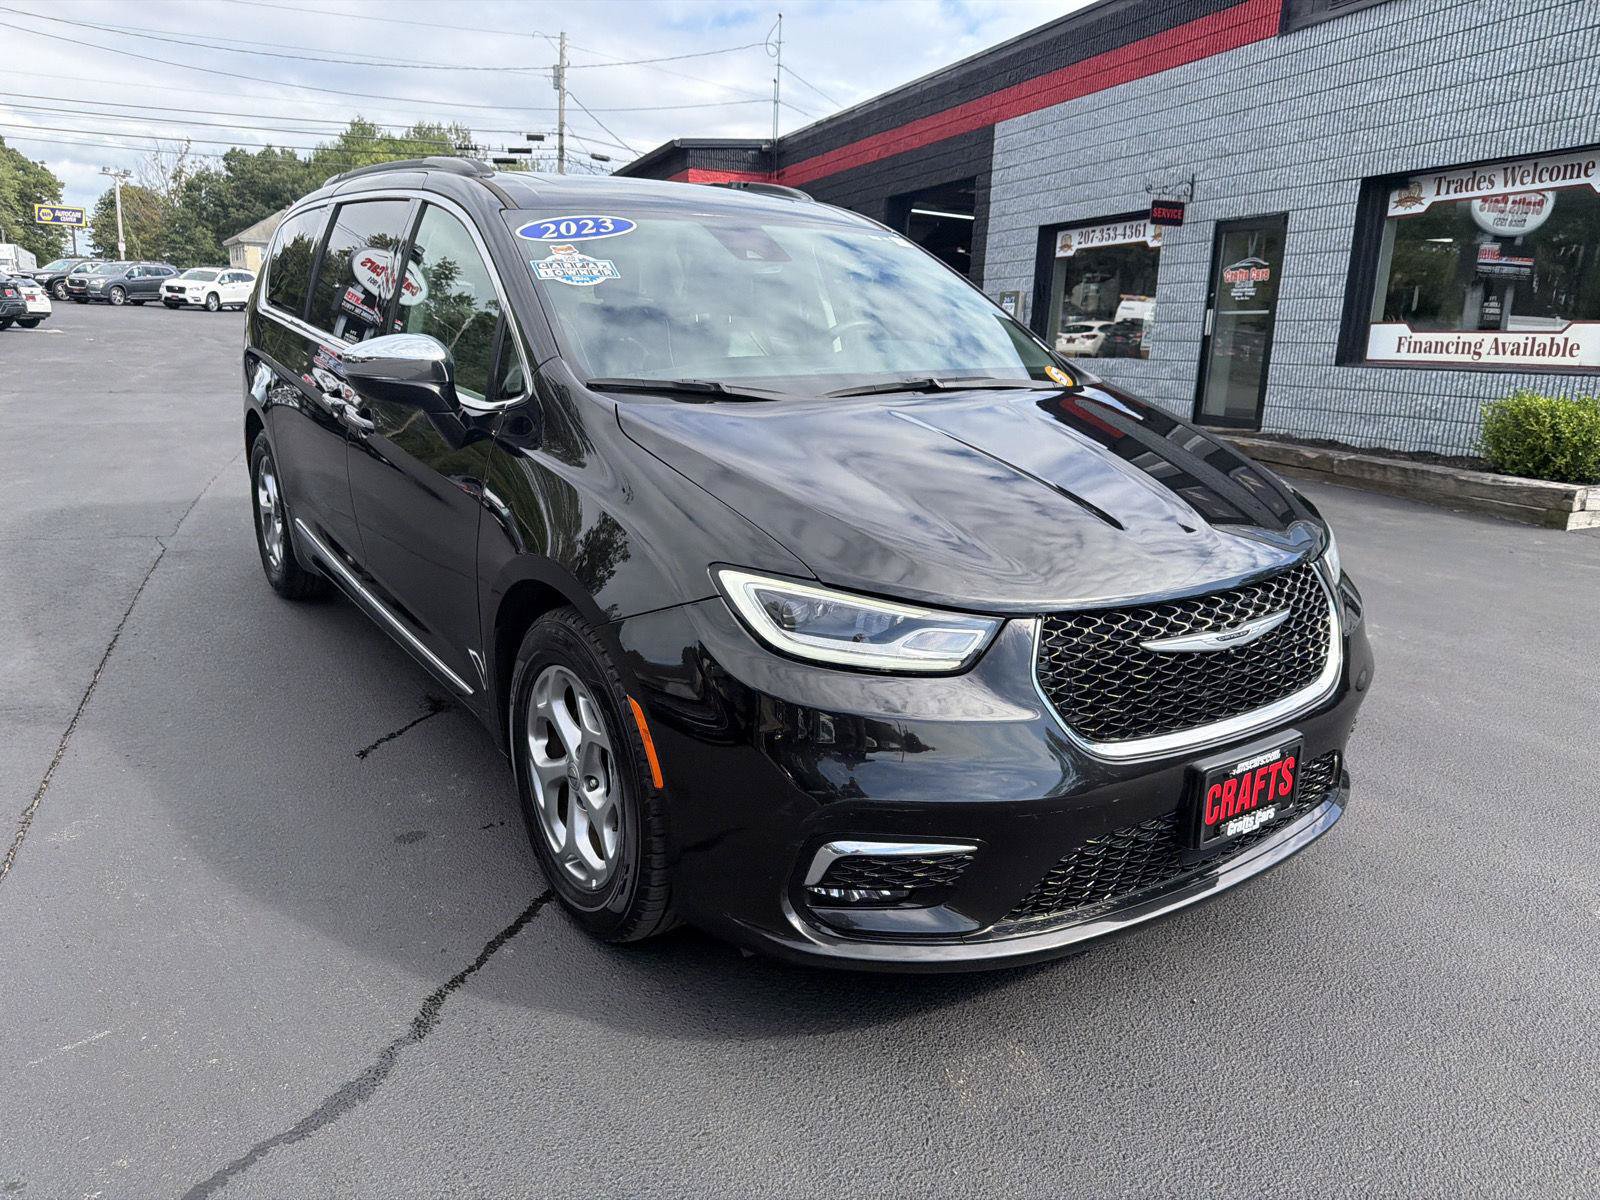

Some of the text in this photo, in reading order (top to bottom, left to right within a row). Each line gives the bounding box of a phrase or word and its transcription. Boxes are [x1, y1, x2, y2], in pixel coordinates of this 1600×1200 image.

[1433, 160, 1596, 197] Trades Welcome
[1152, 207, 1183, 219] SERVICE
[540, 219, 615, 238] 2023
[1077, 222, 1148, 245] 207-353-4361
[1396, 335, 1581, 361] Financing Available
[1204, 756, 1296, 826] CRAFTS
[1226, 807, 1276, 837] Crafts Cars
